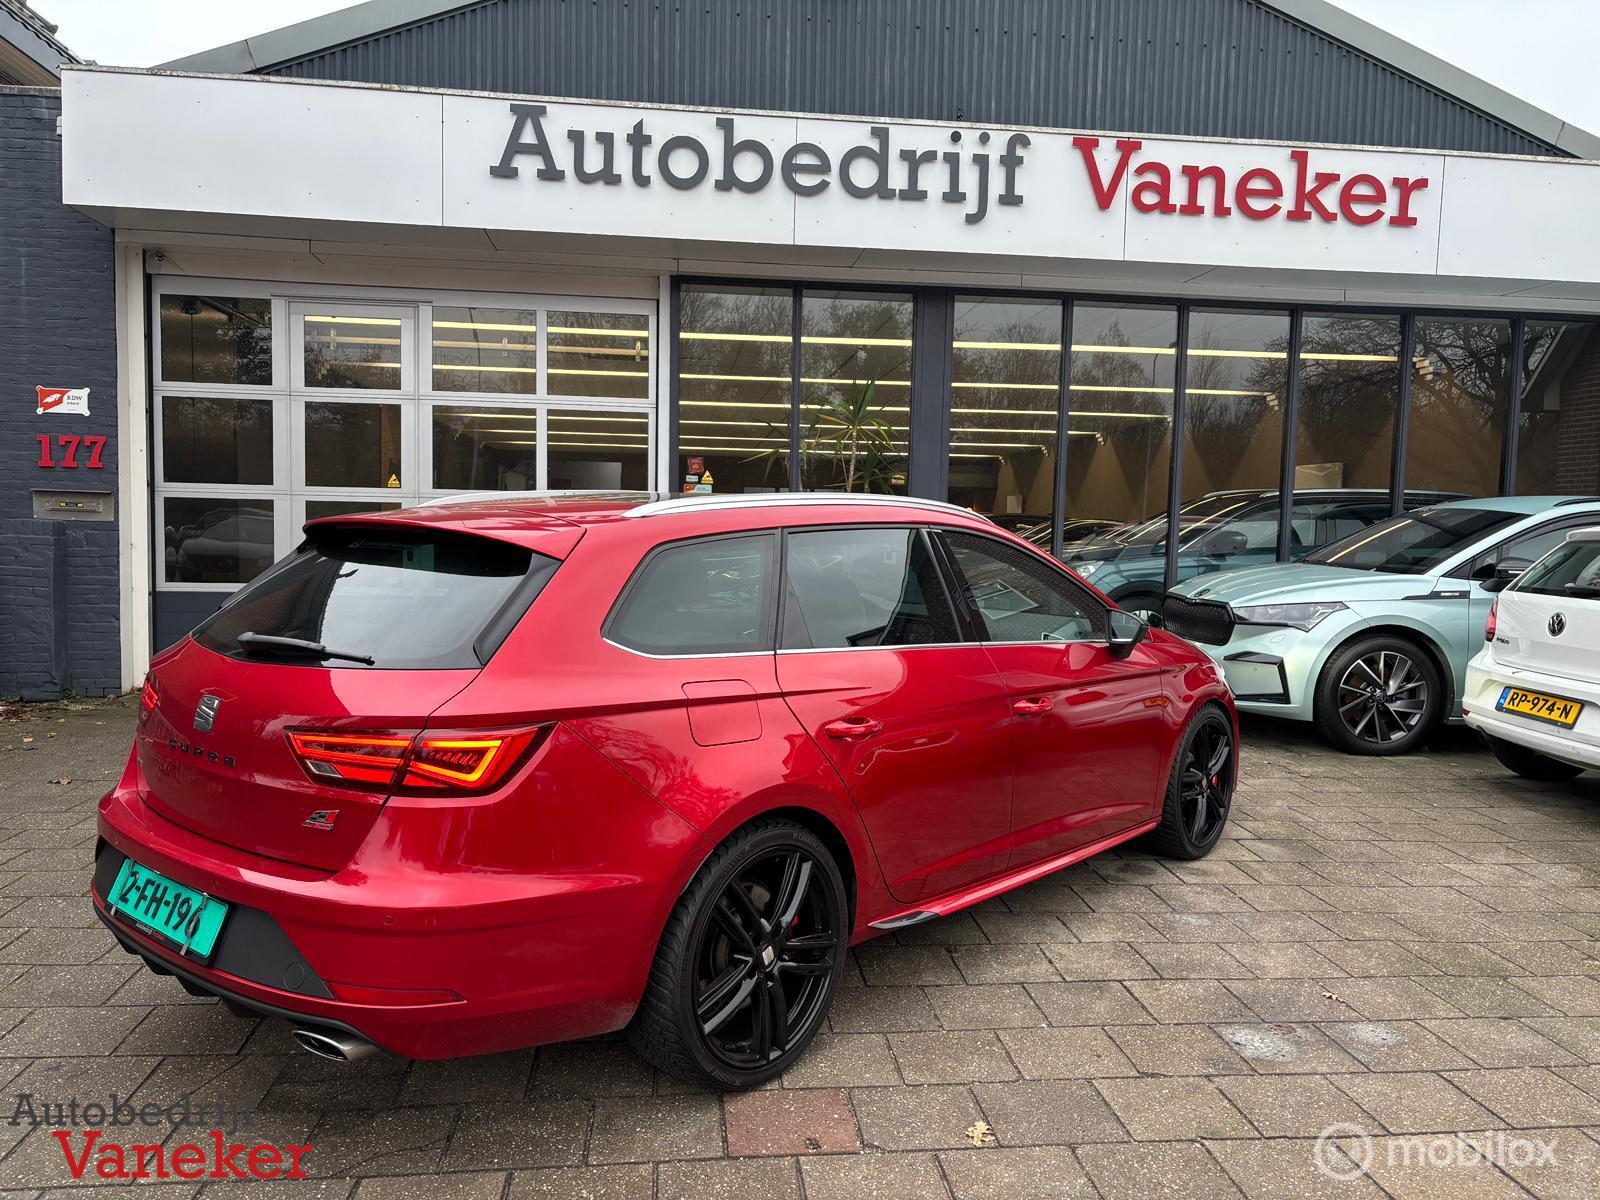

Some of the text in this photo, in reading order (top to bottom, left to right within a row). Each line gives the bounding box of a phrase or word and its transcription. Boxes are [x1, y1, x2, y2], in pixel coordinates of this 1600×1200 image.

[489, 103, 1429, 227] Autobedrijf Vaneker
[36, 434, 107, 469] 177
[1507, 692, 1573, 719] RP-974-N
